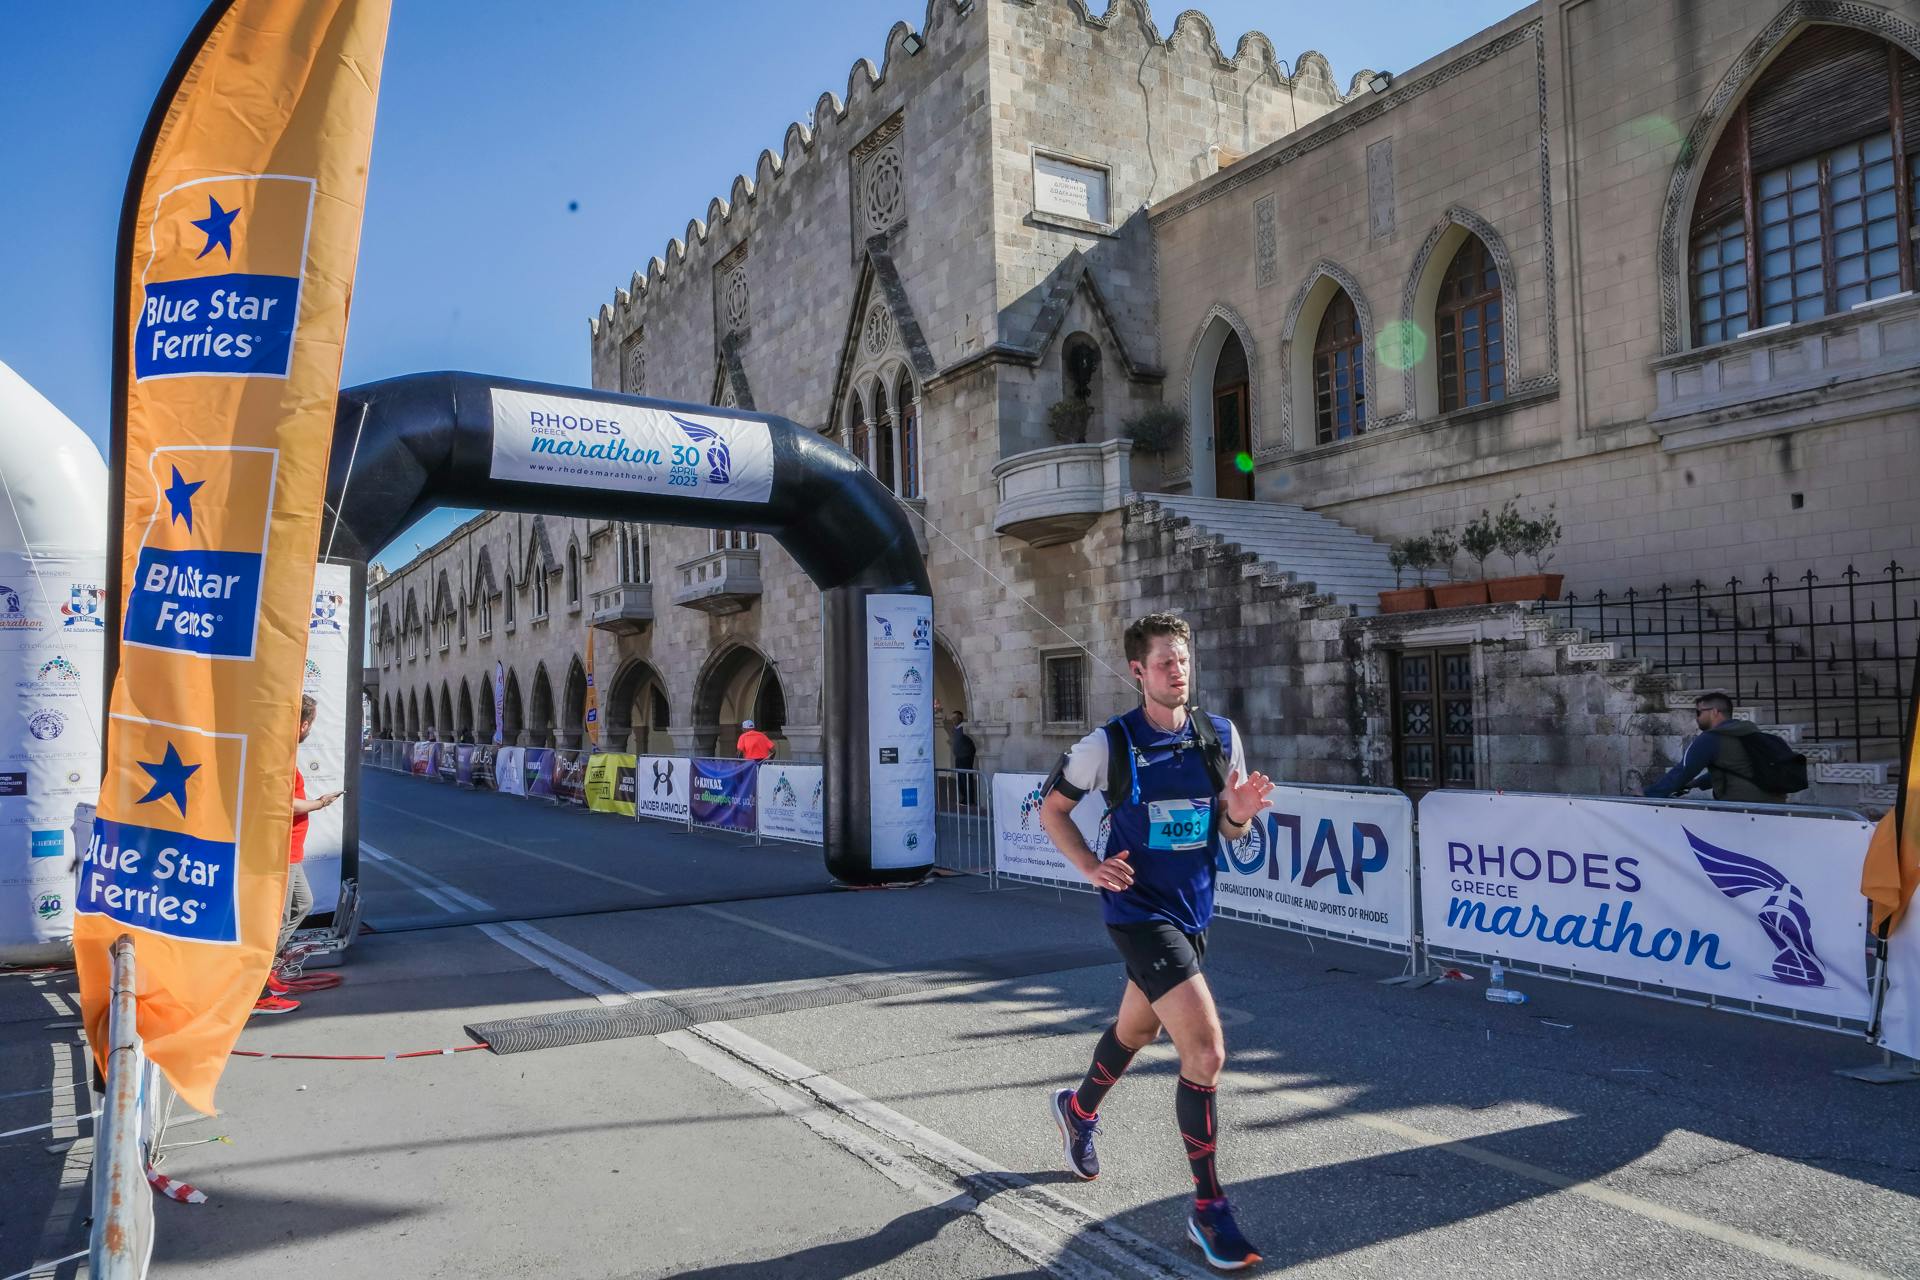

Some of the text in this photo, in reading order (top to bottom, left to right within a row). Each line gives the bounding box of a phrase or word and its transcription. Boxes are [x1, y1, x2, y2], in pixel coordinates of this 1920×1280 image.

[147, 289, 278, 327] Blue Star
[531, 411, 621, 435] RHODES
[531, 427, 566, 437] GREECE
[531, 436, 700, 467] marathon 30
[529, 463, 658, 482] www.rhodesmarathon.gr
[668, 474, 698, 487] 2023
[670, 466, 698, 476] APRIL
[640, 799, 688, 815] UNDER ARMOUR
[1161, 820, 1201, 838] 4093
[153, 847, 220, 887] Star
[1448, 841, 1641, 893] RHODES
[1451, 879, 1518, 898] GREECE
[1220, 882, 1265, 898] ORGANIZATION
[1275, 892, 1303, 908] CULTURE
[1304, 898, 1318, 912] AND
[1319, 902, 1346, 917] SPORTS
[1347, 906, 1358, 918] OF
[1359, 908, 1389, 924] RHODES
[1447, 897, 1731, 970] marathon
